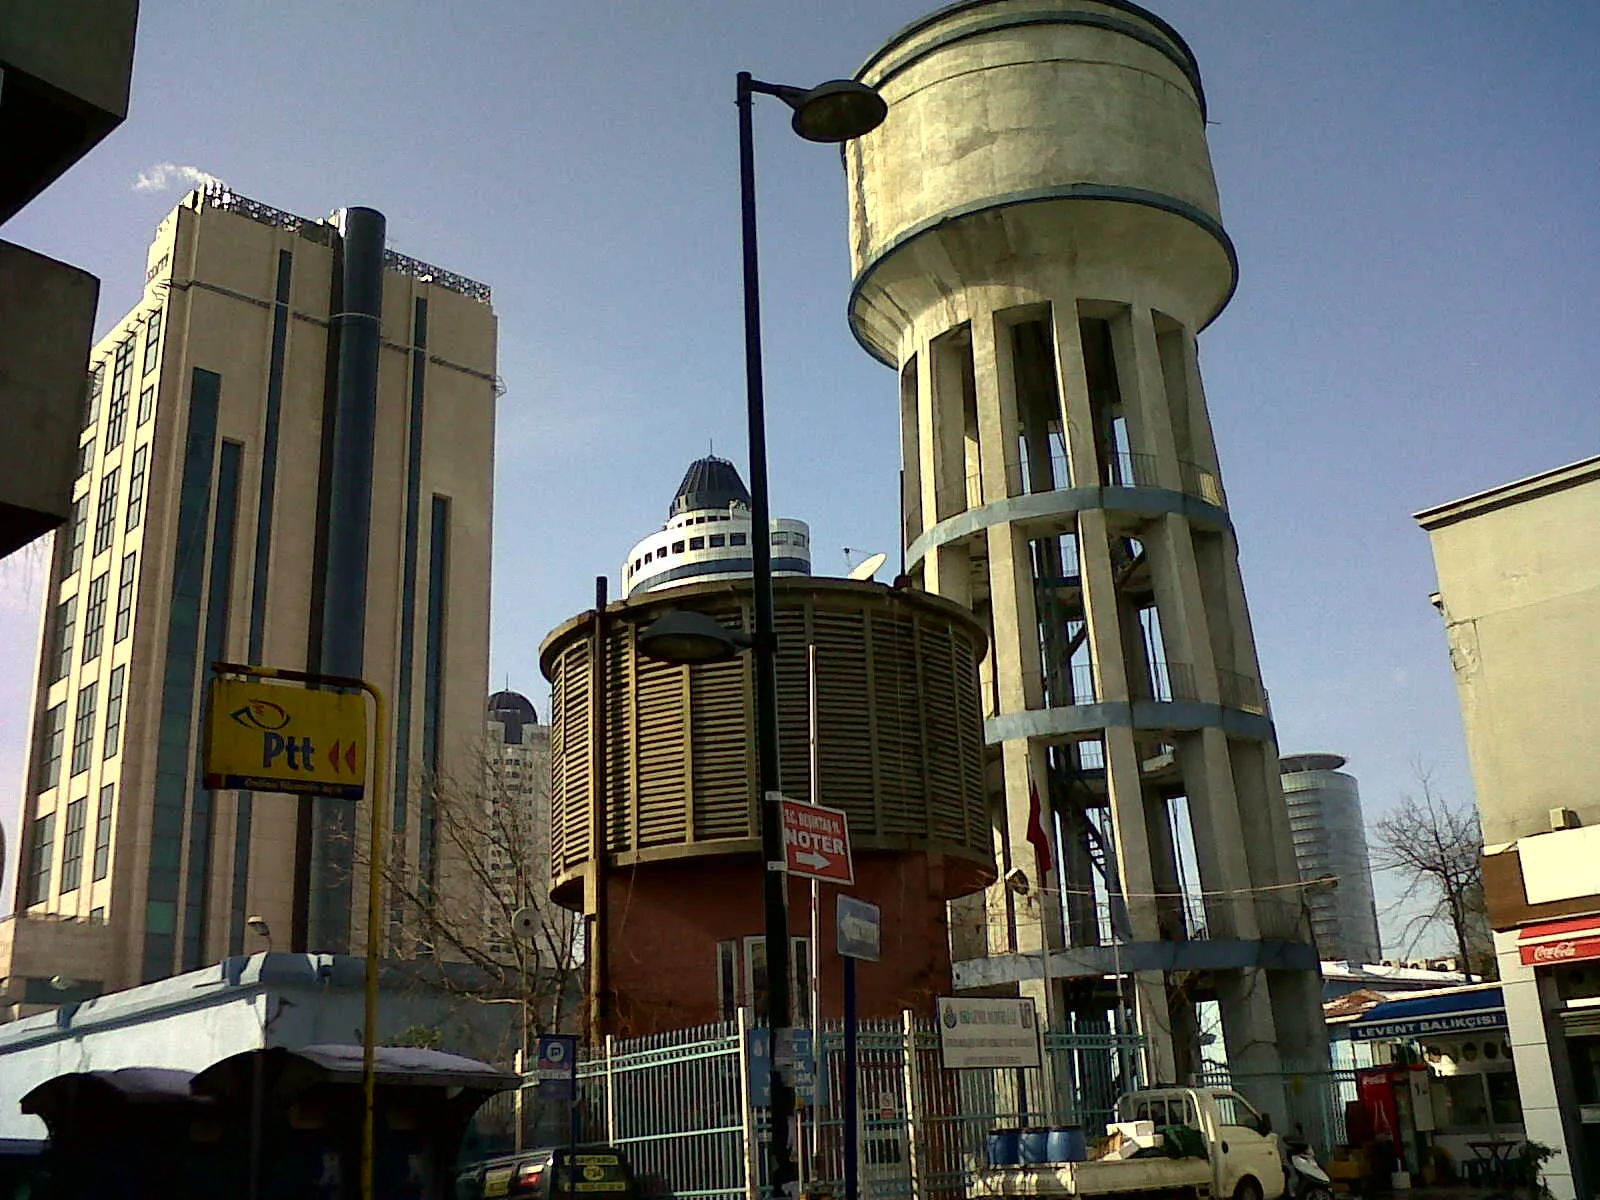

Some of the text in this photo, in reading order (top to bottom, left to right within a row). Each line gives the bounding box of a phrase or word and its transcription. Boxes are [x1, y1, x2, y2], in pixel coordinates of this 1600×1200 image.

[262, 731, 316, 772] Ptt
[783, 827, 845, 855] NOTER
[1357, 1023, 1415, 1037] LEVENT
